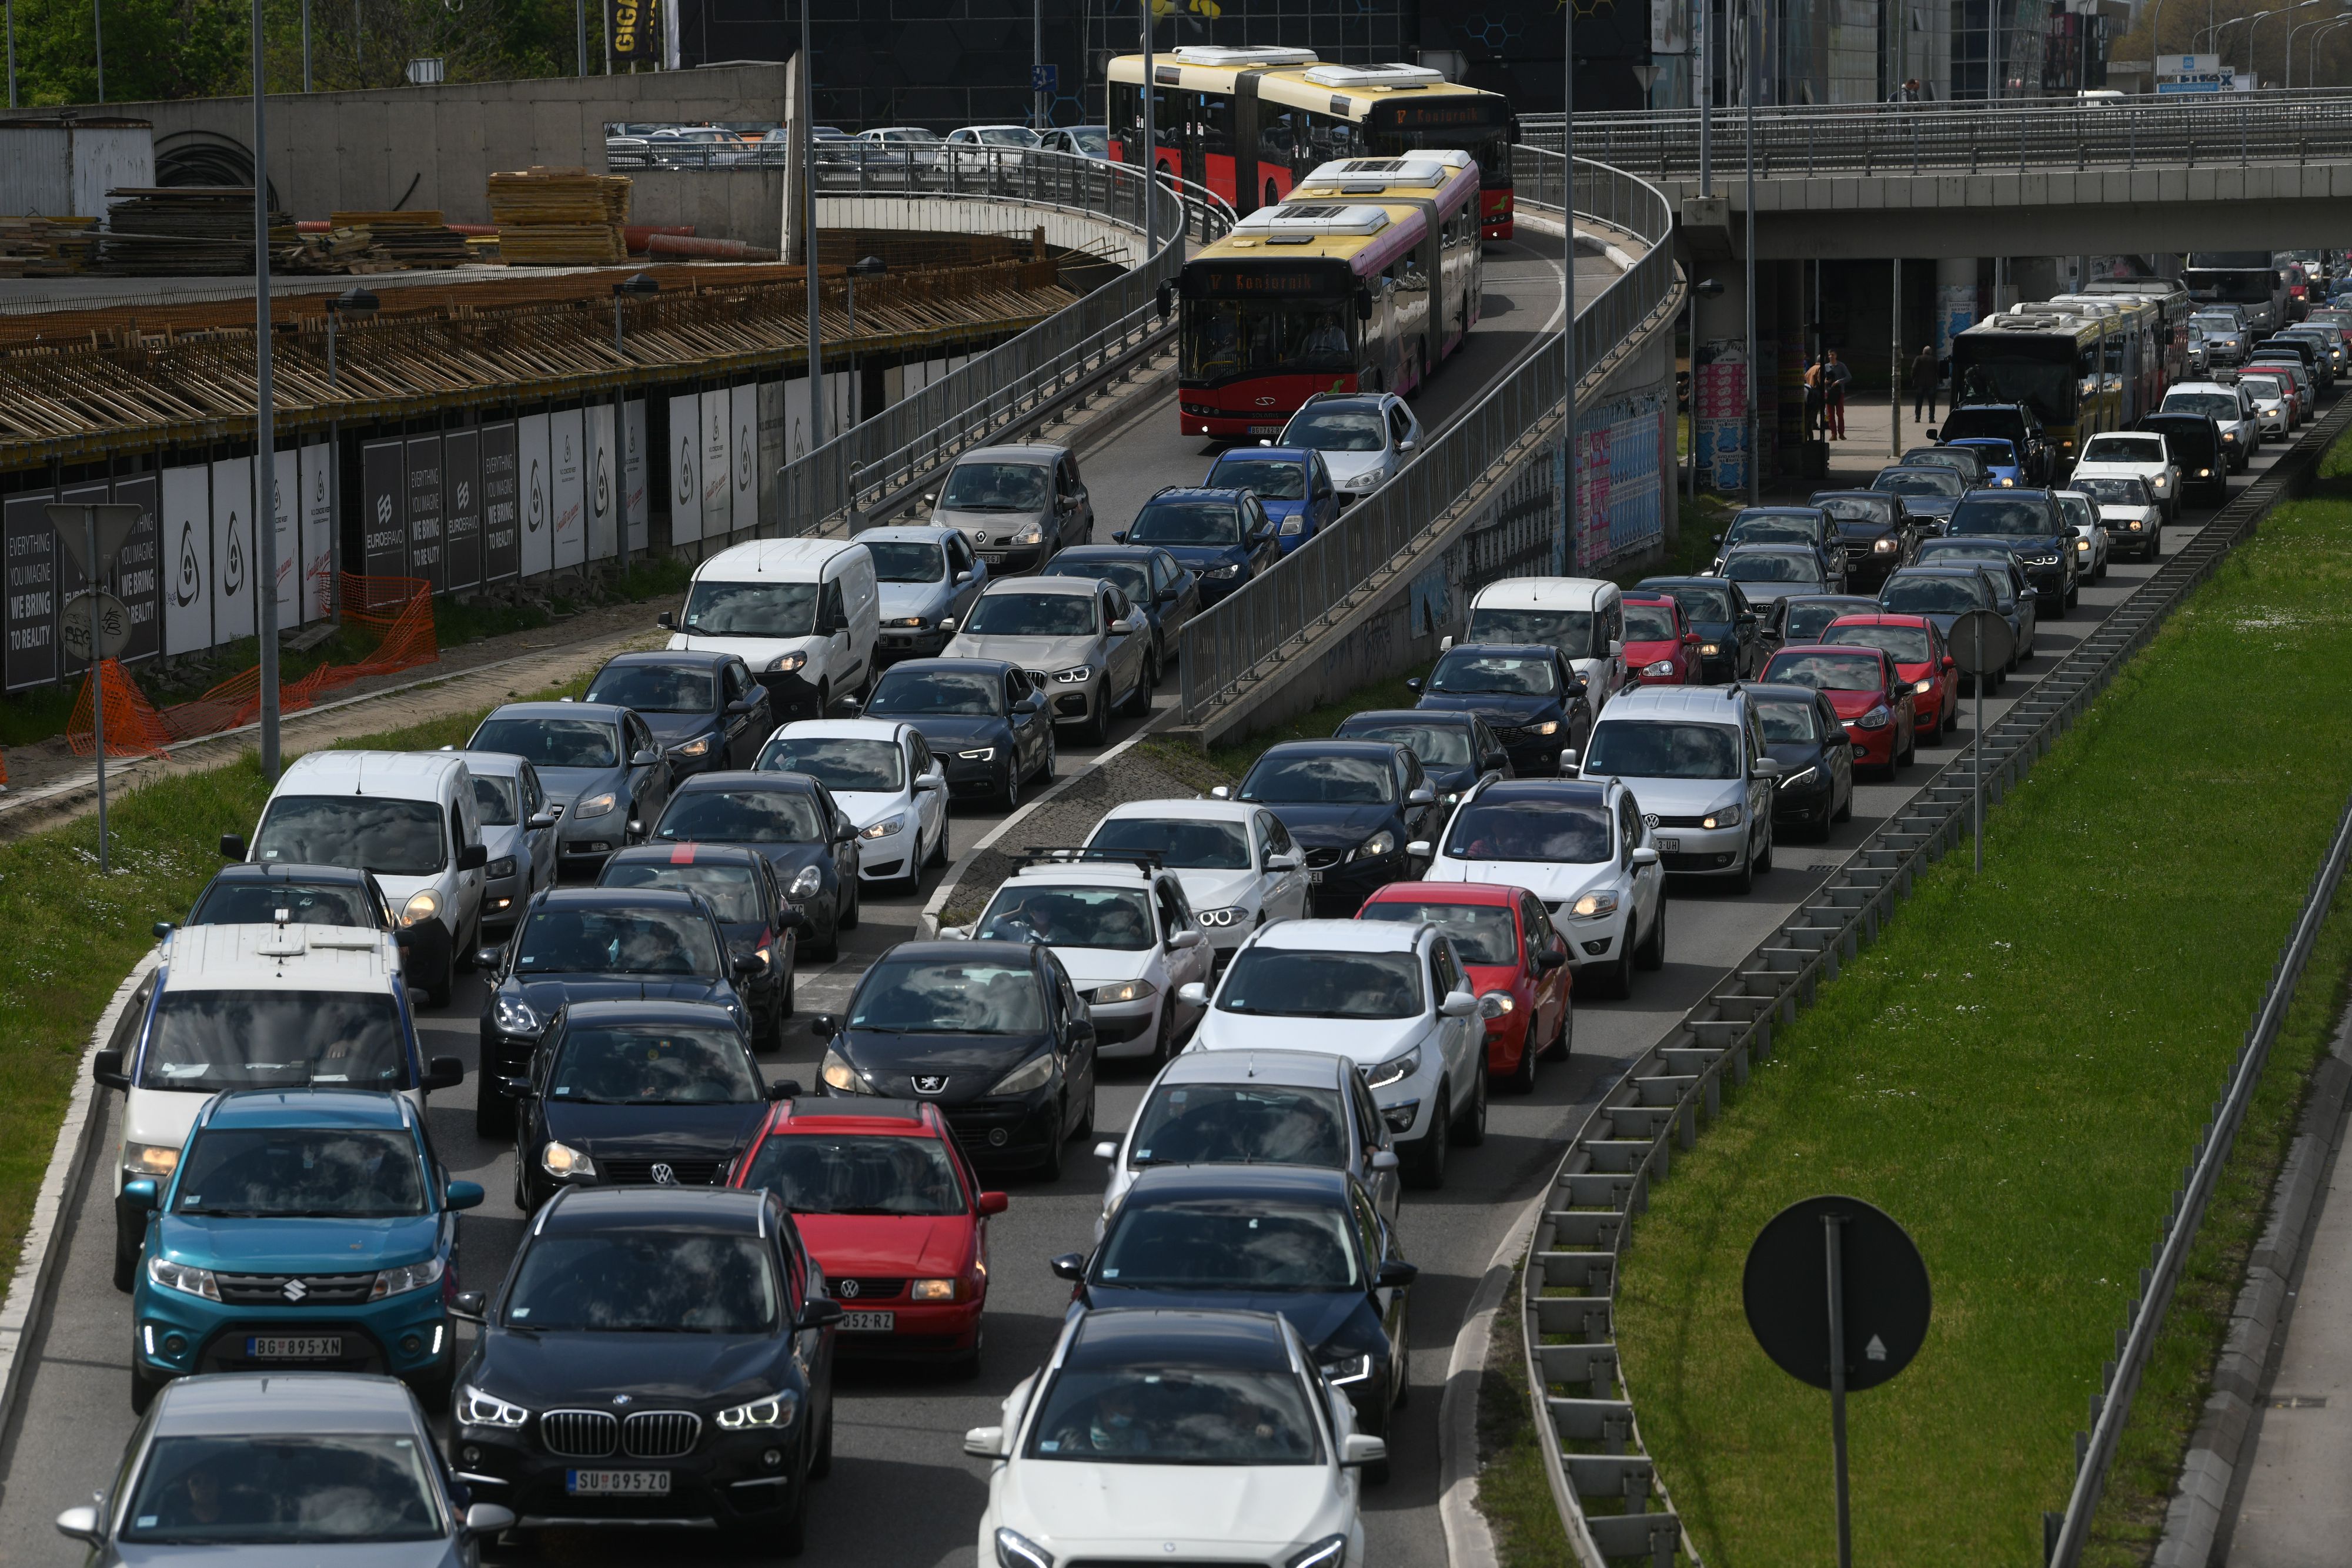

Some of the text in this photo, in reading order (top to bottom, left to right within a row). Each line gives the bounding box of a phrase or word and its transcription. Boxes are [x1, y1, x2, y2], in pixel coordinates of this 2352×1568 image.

[486, 453, 512, 474] EVERYTHING
[412, 468, 438, 488] EVERYTHING
[496, 478, 513, 496] IMAGINE
[412, 493, 439, 513] YOU IMAGINE
[487, 501, 513, 524] WE BRING
[413, 517, 439, 541] WE BRING
[449, 514, 478, 534] EUROBRAVO
[9, 533, 50, 557] EVERYTHING
[367, 529, 403, 549] EUROBRAVO
[489, 529, 513, 550] TO REALITY
[122, 541, 153, 565] YOU IMAGINE
[413, 545, 439, 567] TO REALITY
[10, 563, 51, 586] YOU IMAGINE
[122, 569, 154, 597] WE BRING
[11, 591, 51, 620] WE BRING
[131, 600, 154, 624] REALITY
[11, 625, 51, 651] TO REALITY
